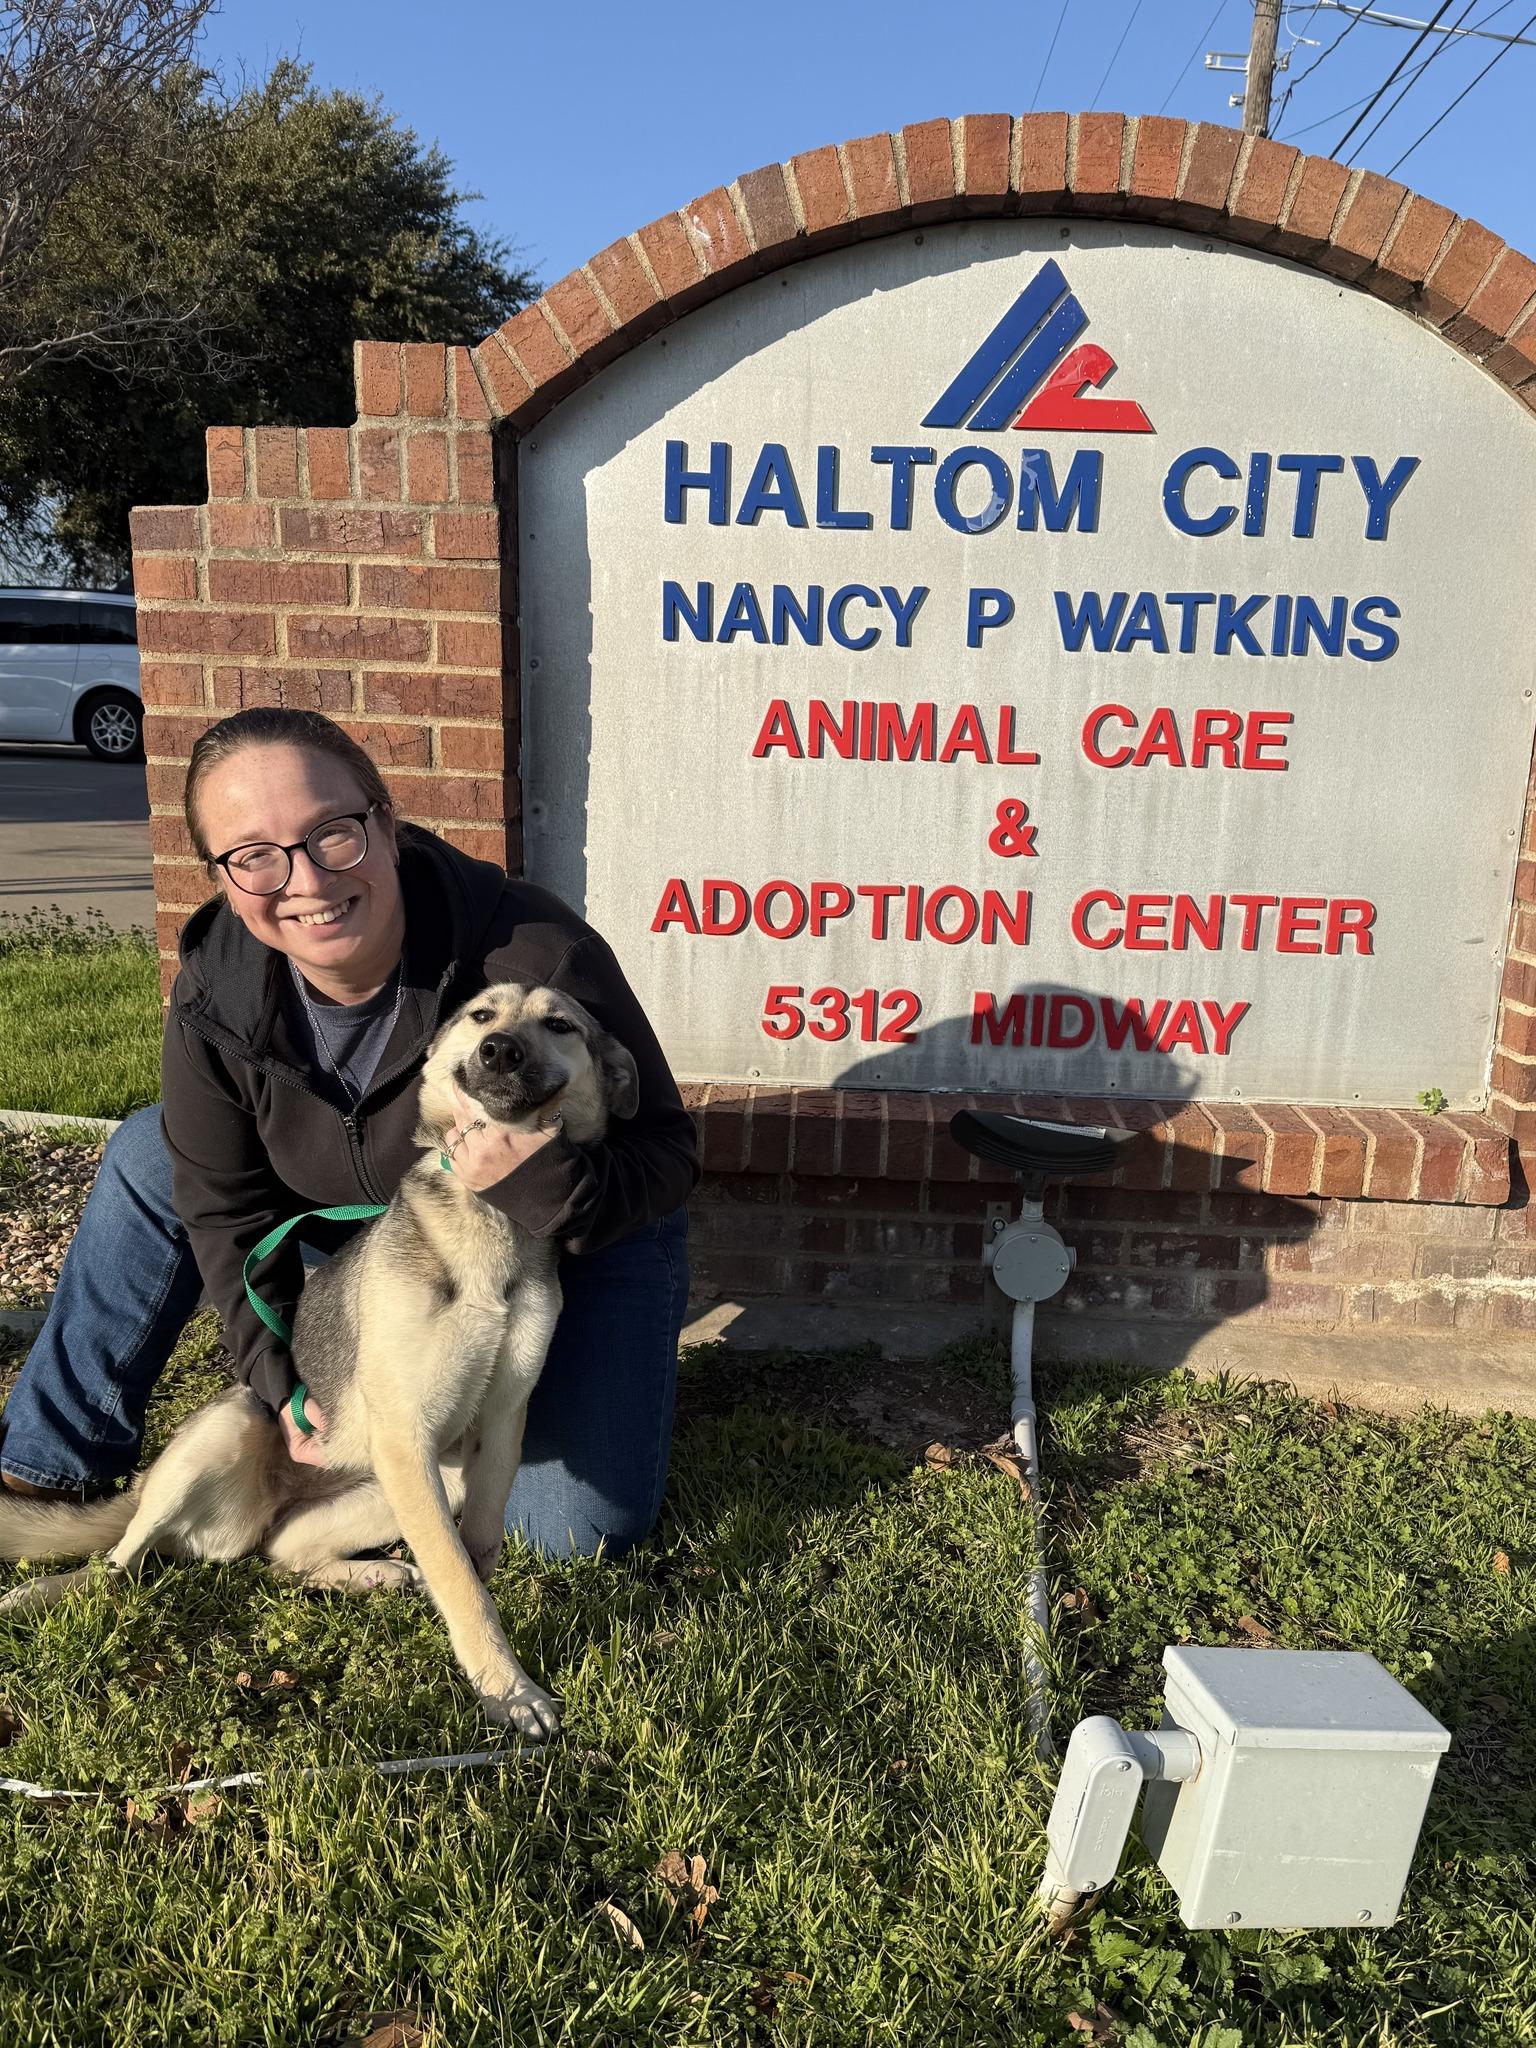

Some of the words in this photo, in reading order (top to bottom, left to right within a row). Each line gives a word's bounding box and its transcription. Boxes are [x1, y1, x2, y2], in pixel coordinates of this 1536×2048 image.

[662, 440, 1103, 534] HALTOM
[1163, 447, 1420, 541] CITY
[661, 580, 930, 652] NANCY
[967, 588, 1013, 649] P
[1055, 591, 1401, 661] WATKINS
[752, 699, 1040, 766] ANIMAL
[1082, 703, 1295, 771] CARE
[988, 798, 1038, 858] &
[651, 878, 1033, 945] ADOPTION
[1071, 890, 1377, 957] CENTER
[761, 986, 922, 1044] 5312
[971, 992, 1251, 1056] MIDWAY
